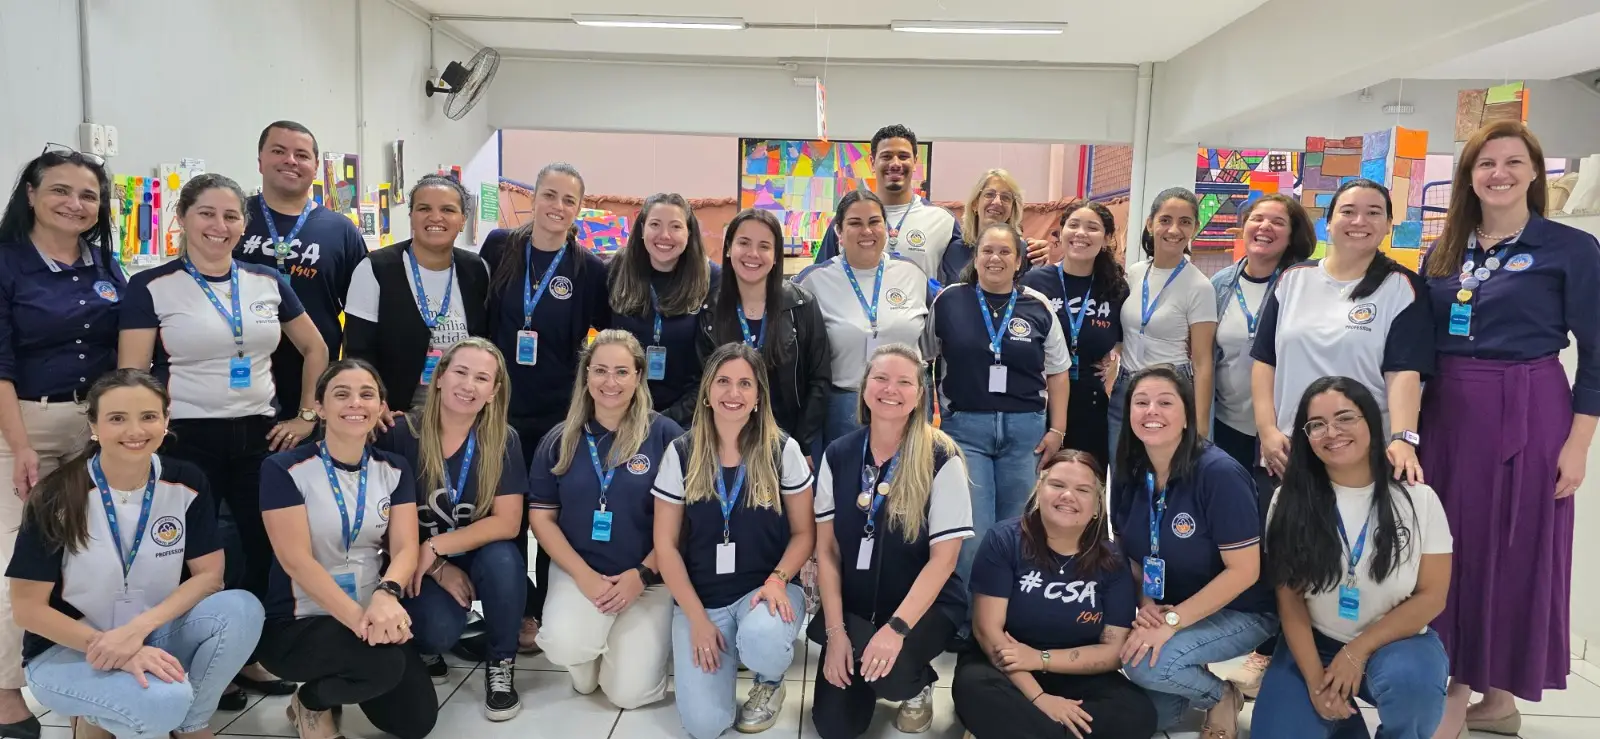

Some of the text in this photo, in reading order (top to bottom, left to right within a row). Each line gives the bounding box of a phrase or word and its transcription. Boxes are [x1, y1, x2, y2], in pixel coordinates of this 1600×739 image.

[290, 264, 317, 279] 1947
[1091, 319, 1111, 328] 1947
[156, 548, 184, 558] PROFESSOR
[1019, 570, 1098, 609] #CSA
